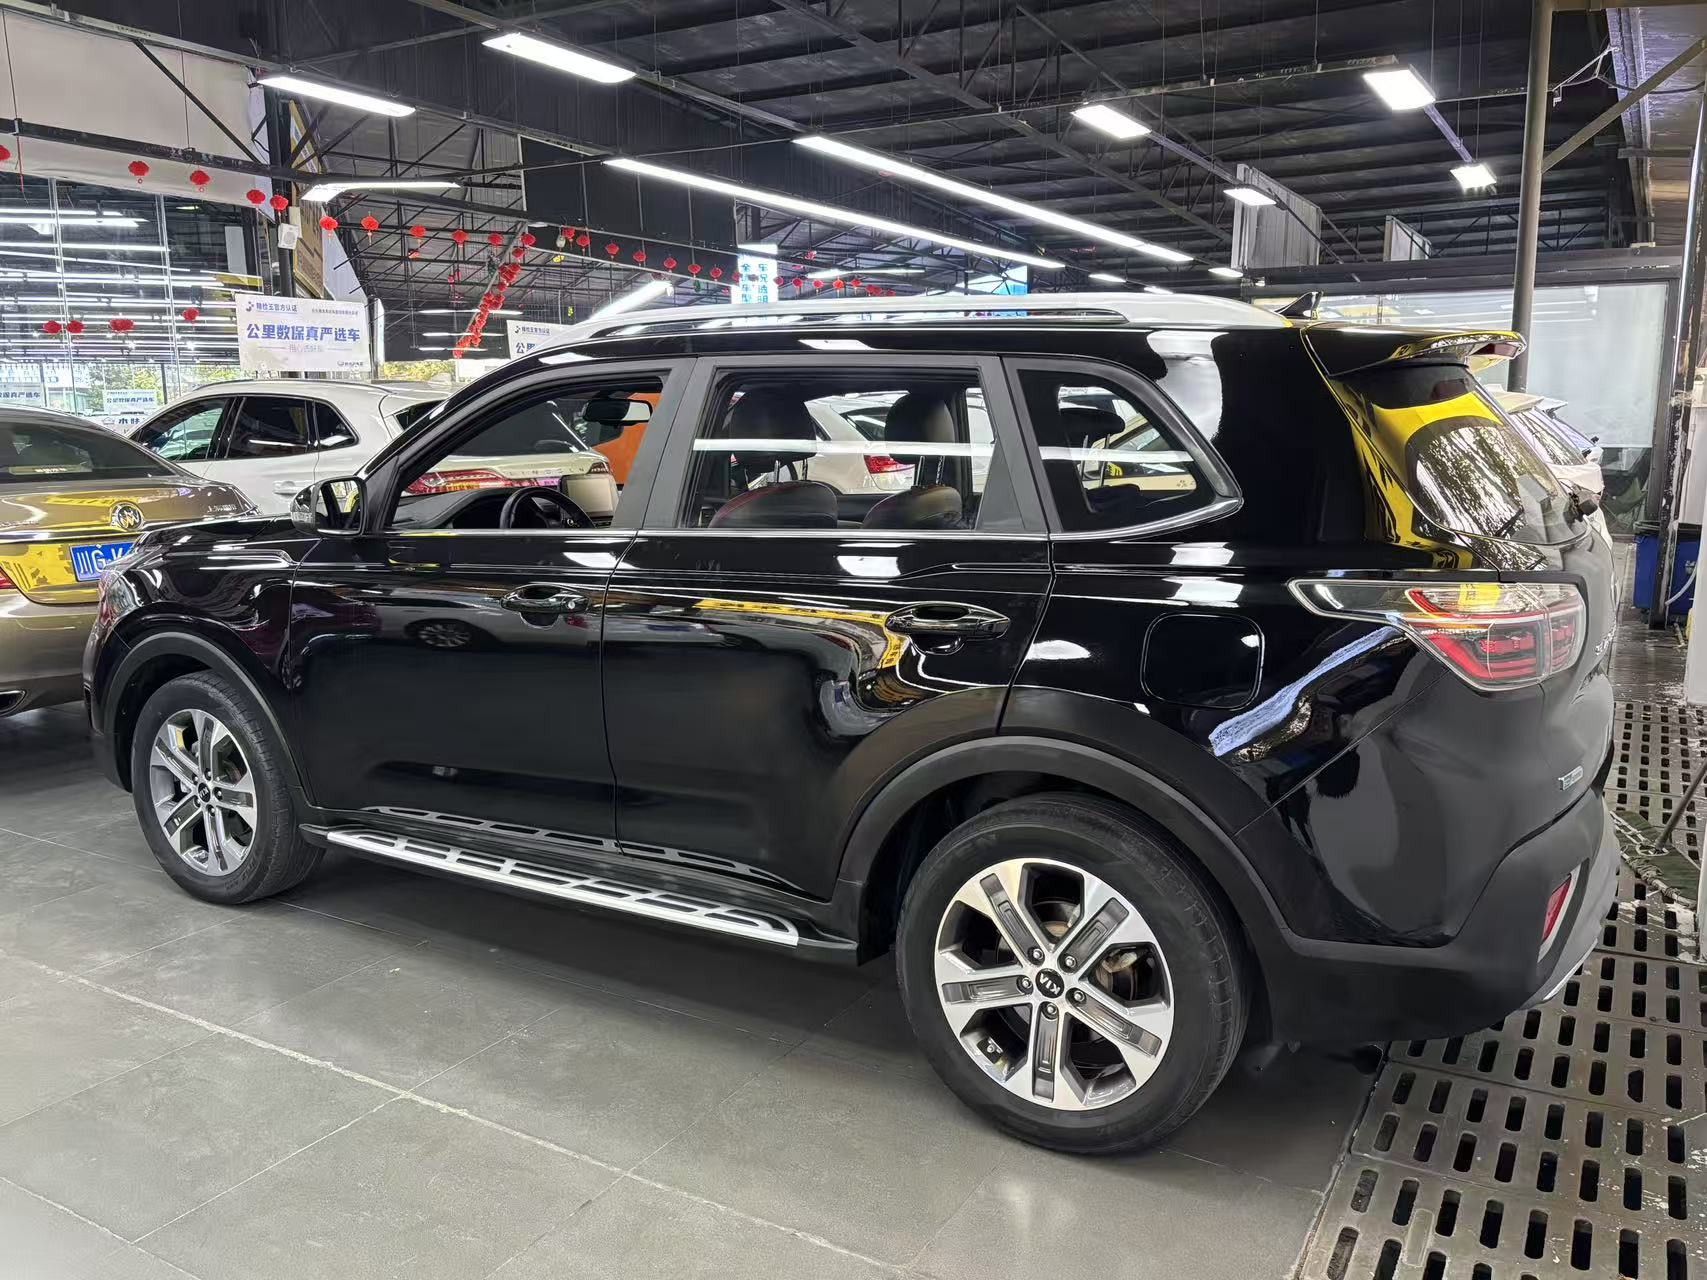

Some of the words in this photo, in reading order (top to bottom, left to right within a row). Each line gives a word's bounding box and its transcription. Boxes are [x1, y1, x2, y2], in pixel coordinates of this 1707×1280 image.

[247, 323, 361, 342] 公里数保真严选车
[1039, 972, 1061, 996] KIA
